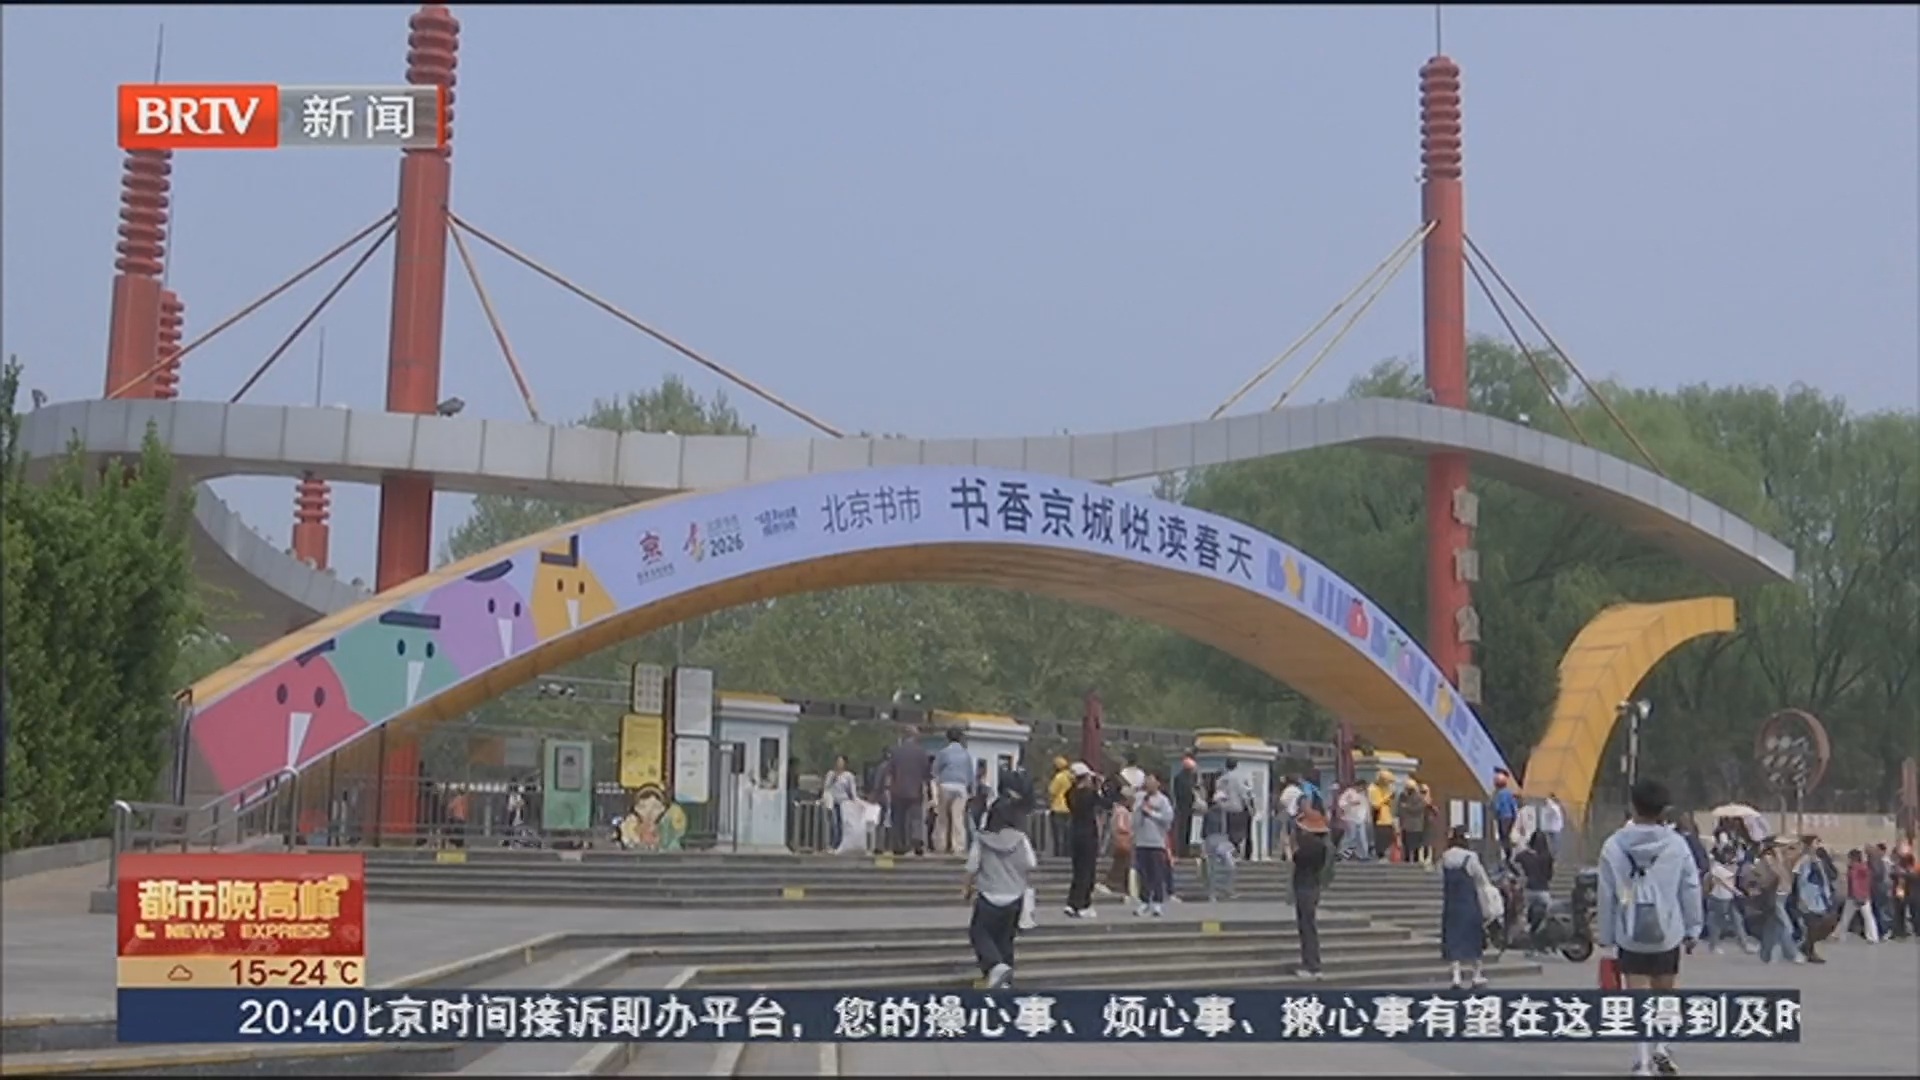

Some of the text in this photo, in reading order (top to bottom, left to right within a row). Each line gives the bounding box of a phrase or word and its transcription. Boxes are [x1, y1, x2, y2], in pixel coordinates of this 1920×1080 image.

[820, 485, 922, 534] 北京书市
[950, 476, 1254, 580] 书香京城悦读春天
[709, 532, 745, 558] 2026
